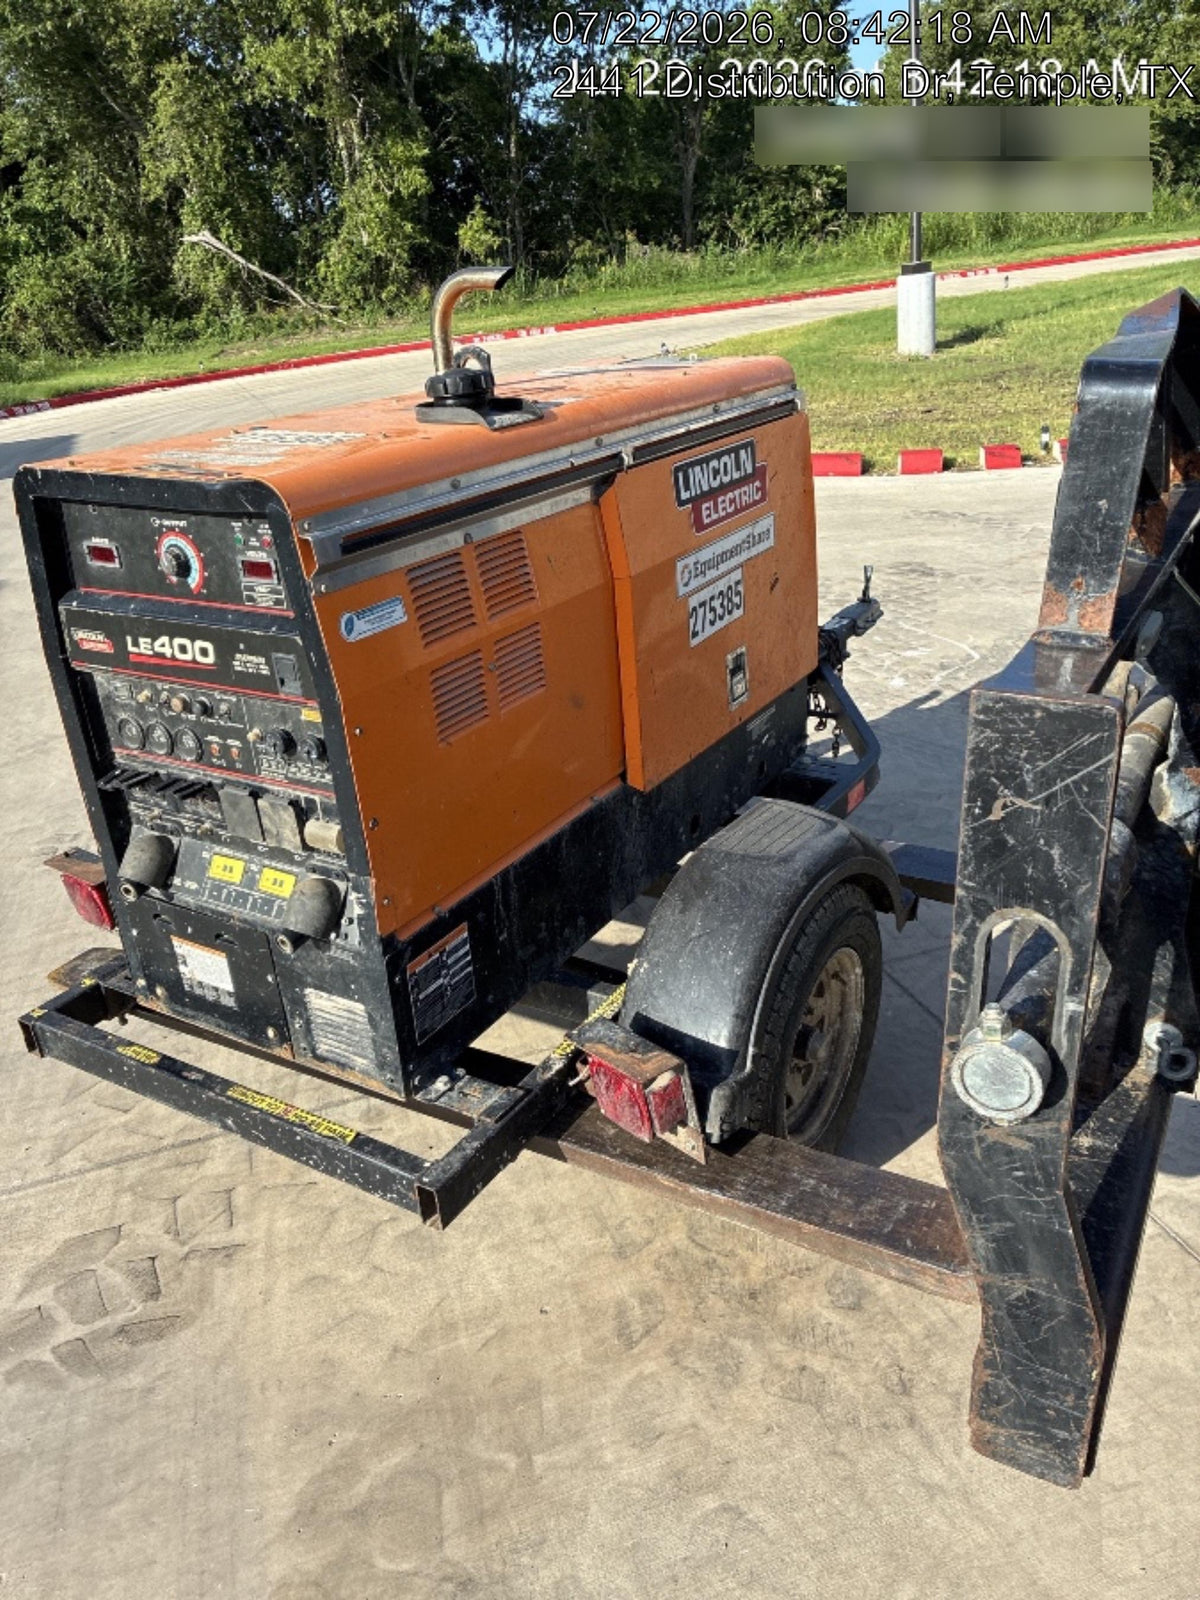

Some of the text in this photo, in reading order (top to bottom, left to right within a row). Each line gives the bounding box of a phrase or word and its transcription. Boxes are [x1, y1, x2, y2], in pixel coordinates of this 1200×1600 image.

[677, 446, 754, 500] LINCOLN
[701, 480, 763, 525] ELECTRIC
[693, 527, 771, 579] EquipmentShare
[689, 579, 742, 641] 275385
[126, 635, 215, 664] LE400
